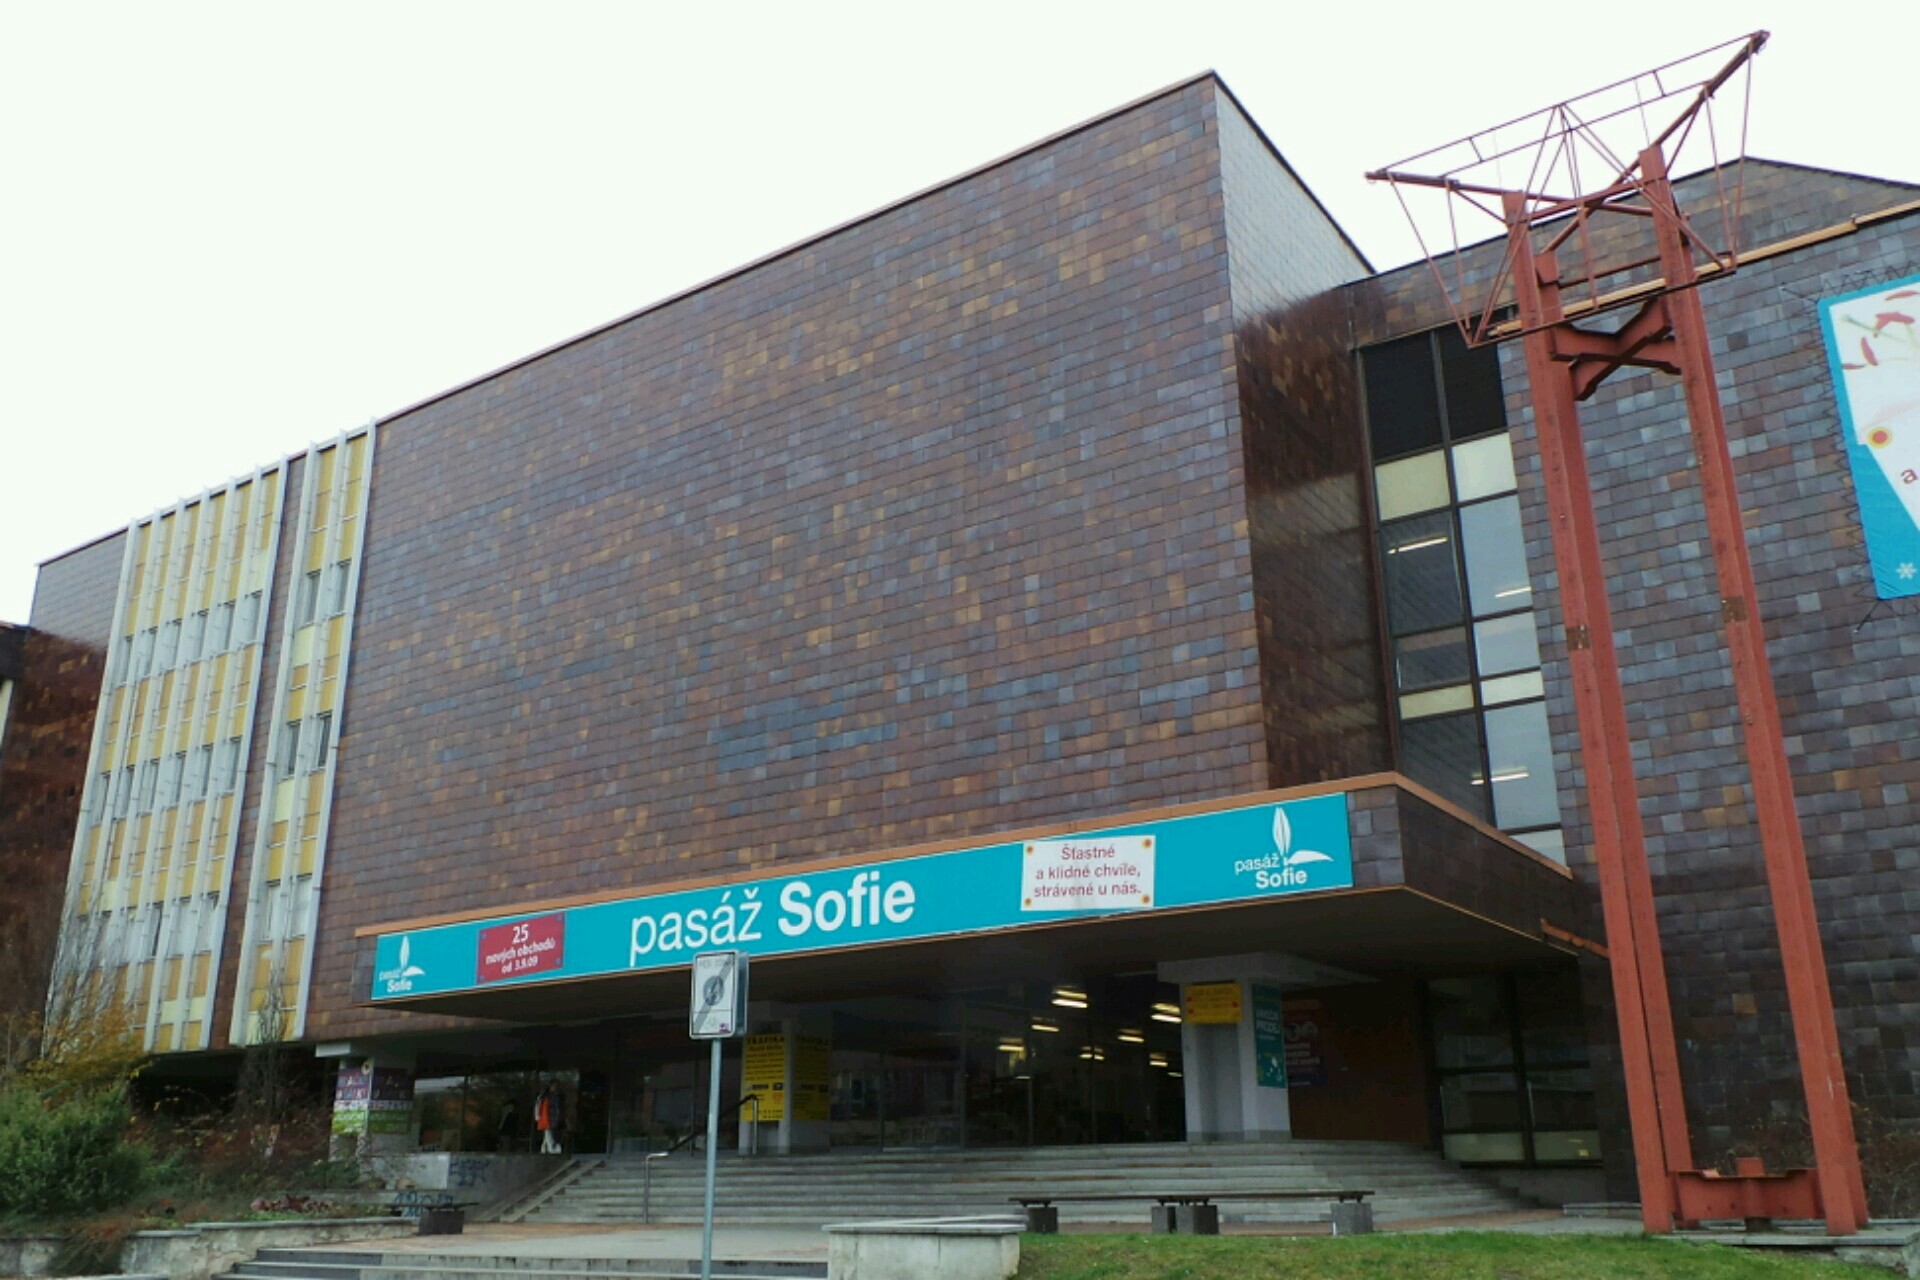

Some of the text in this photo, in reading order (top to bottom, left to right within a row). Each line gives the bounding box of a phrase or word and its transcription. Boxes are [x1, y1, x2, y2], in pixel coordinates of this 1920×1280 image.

[1036, 868, 1044, 880] a
[1048, 863, 1091, 879] klidné
[1234, 852, 1280, 875] pasáž
[1256, 867, 1308, 889] Sofie
[1033, 880, 1142, 898] strávené u nás.
[630, 871, 916, 968] pasáž Sofie
[512, 923, 529, 944] 25
[485, 947, 516, 965] nových
[501, 961, 512, 974] od
[387, 978, 412, 992] Sofie
